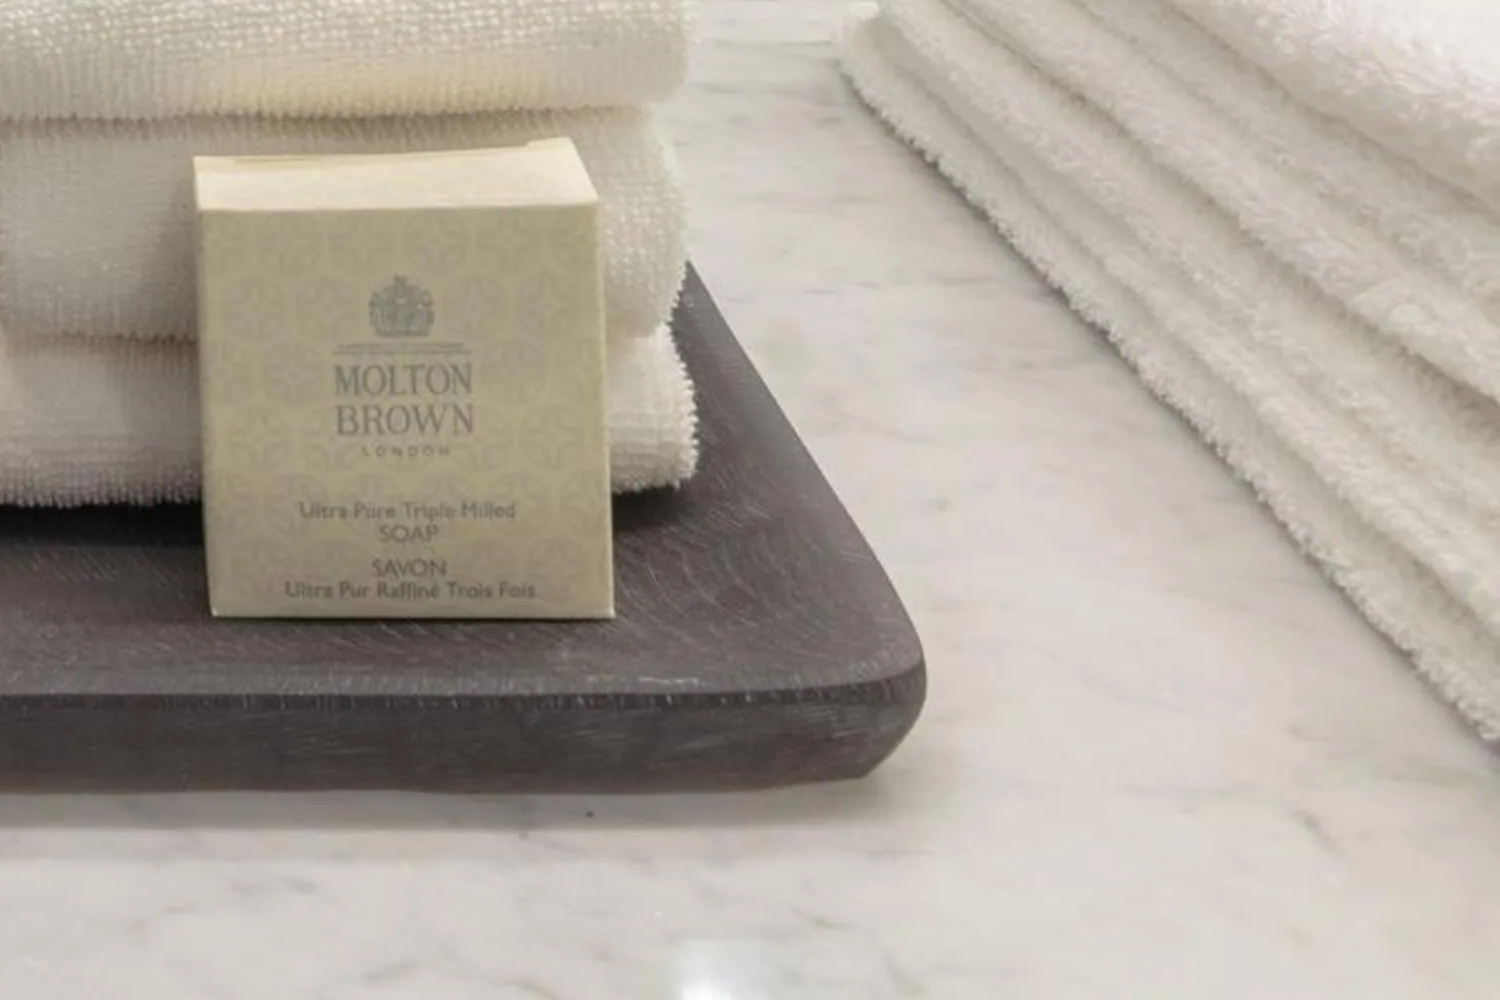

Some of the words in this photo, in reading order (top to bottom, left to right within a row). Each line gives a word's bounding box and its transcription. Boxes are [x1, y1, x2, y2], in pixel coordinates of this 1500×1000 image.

[333, 362, 473, 396] MOLTON
[335, 402, 474, 436] BROWN
[361, 445, 450, 457] LONDON
[299, 502, 348, 519] Ultra
[354, 502, 396, 519] Pure
[403, 502, 457, 523] Triple
[461, 501, 516, 519] Milled
[379, 524, 439, 543] SOAP
[372, 558, 447, 577] SAVON
[284, 581, 333, 598] Ultra
[339, 581, 371, 598] Pur
[446, 581, 493, 598] Trois
[499, 581, 536, 598] Fois
